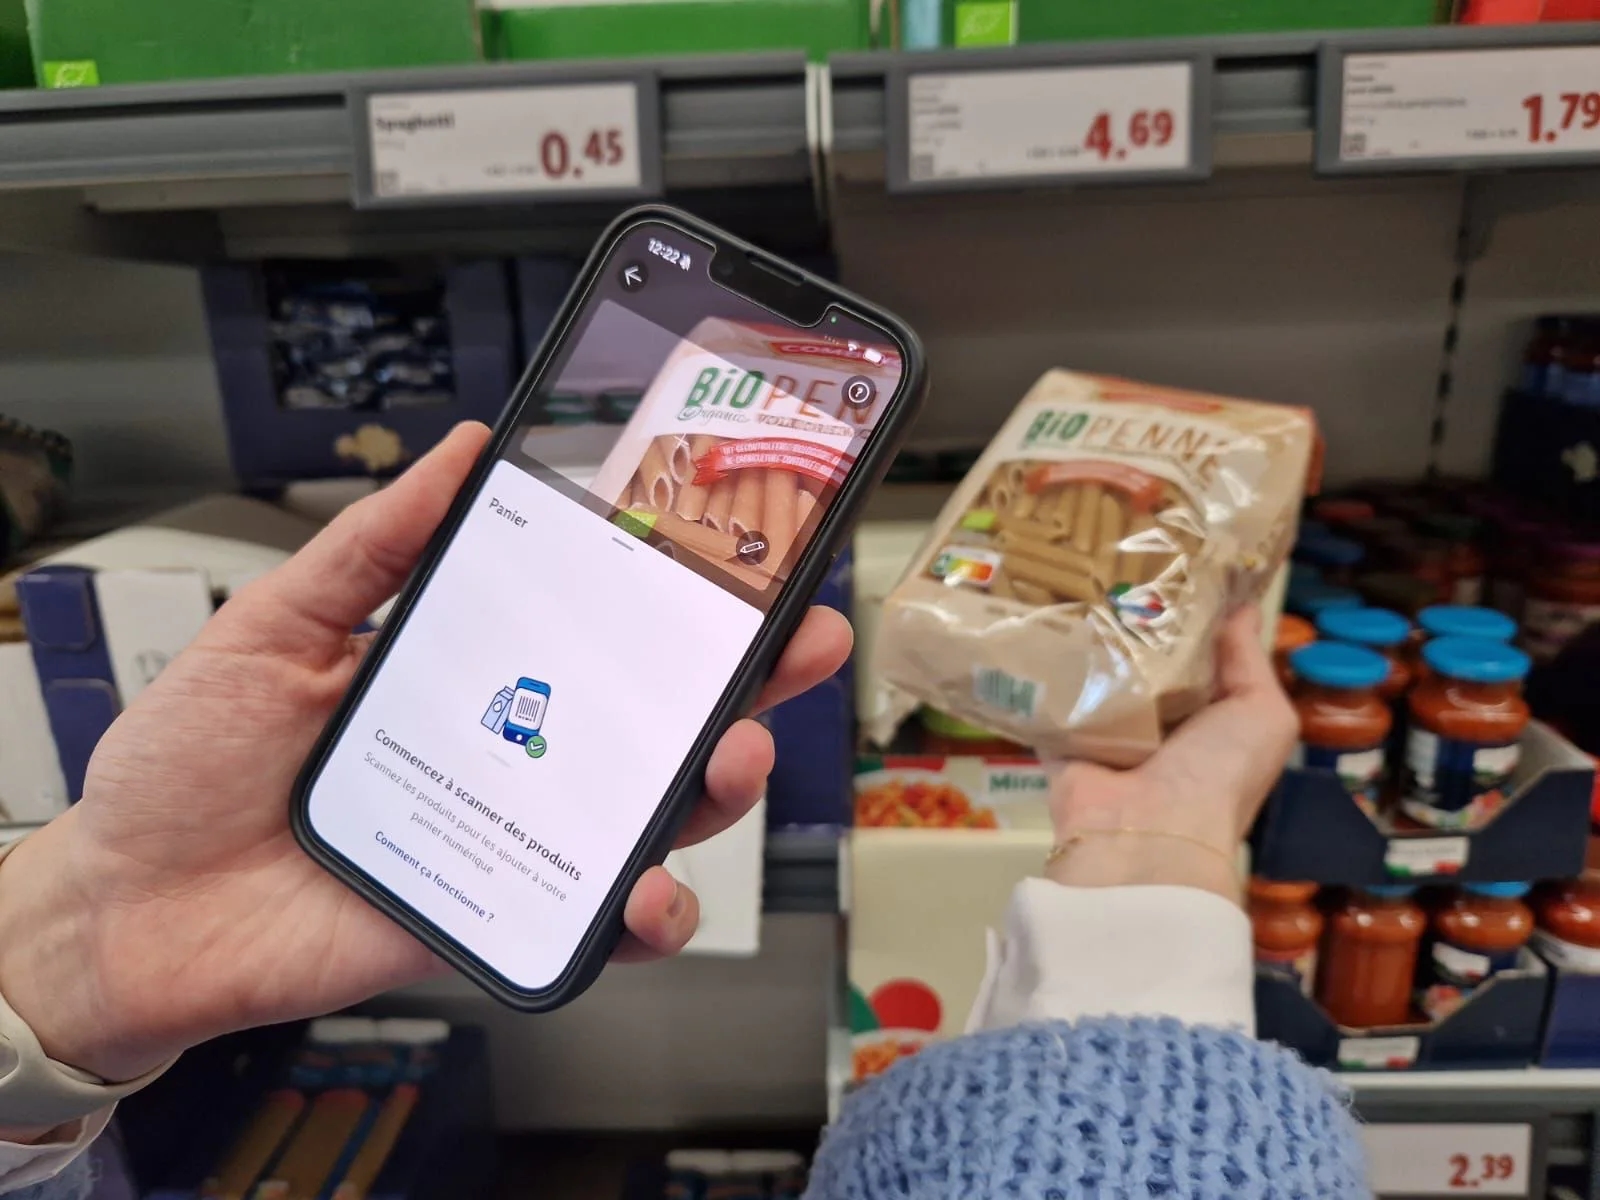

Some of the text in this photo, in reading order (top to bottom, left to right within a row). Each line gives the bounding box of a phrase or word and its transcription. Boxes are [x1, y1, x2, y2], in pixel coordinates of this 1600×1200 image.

[1084, 108, 1175, 161] 4.69
[1522, 91, 1600, 144] 1.79
[540, 129, 624, 179] 0.45
[648, 238, 681, 264] 12:22
[488, 497, 529, 529] Panier
[364, 751, 567, 901] Scannez les produits pour les ajouter à votre
[375, 728, 582, 881] Commencez à scanner des produits
[410, 811, 494, 875] panier numérique
[375, 831, 495, 923] Comment ça fonctionne ?
[1448, 1153, 1515, 1187] 2.39
